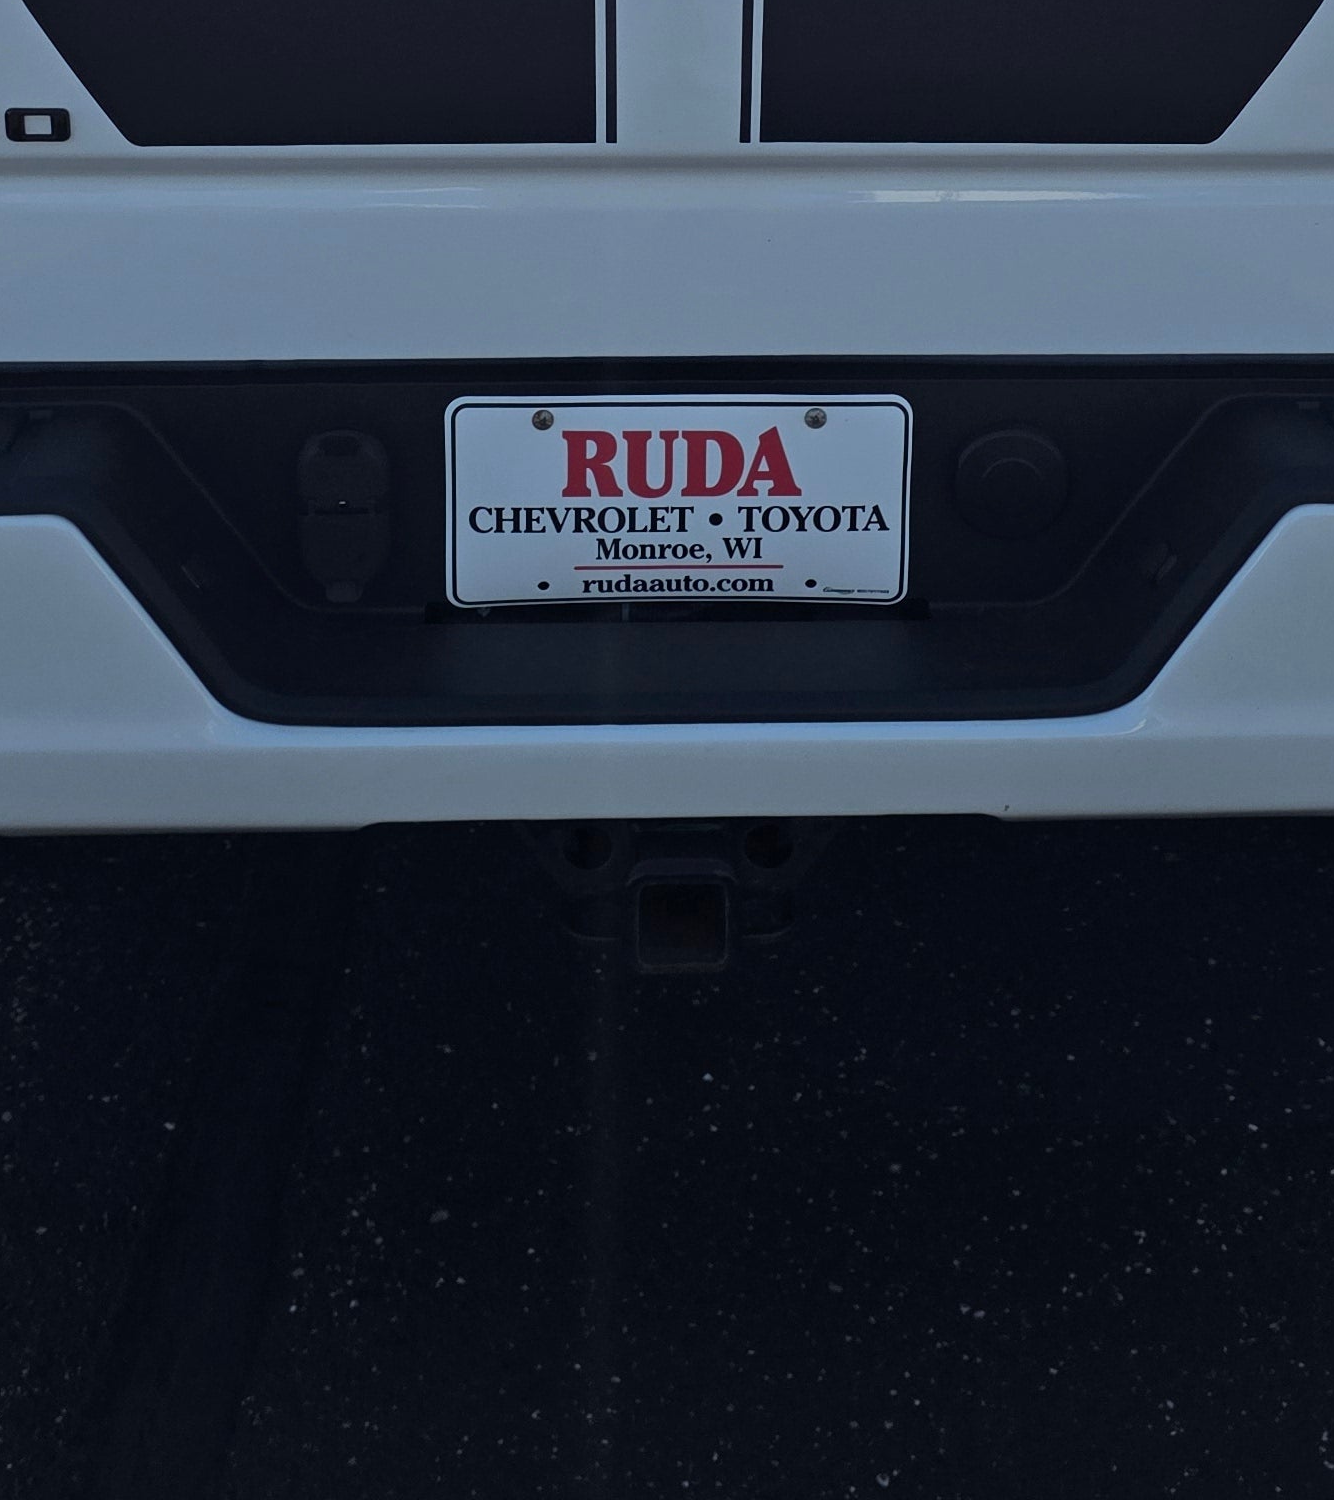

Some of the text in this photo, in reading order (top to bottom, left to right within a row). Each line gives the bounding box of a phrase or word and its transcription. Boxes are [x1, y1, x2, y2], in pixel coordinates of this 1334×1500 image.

[562, 426, 802, 498] RUDA
[468, 504, 890, 534] CHEVROLET TOYOTA
[595, 537, 763, 563] Monroe, WI
[582, 573, 775, 593] rudaauto.com
